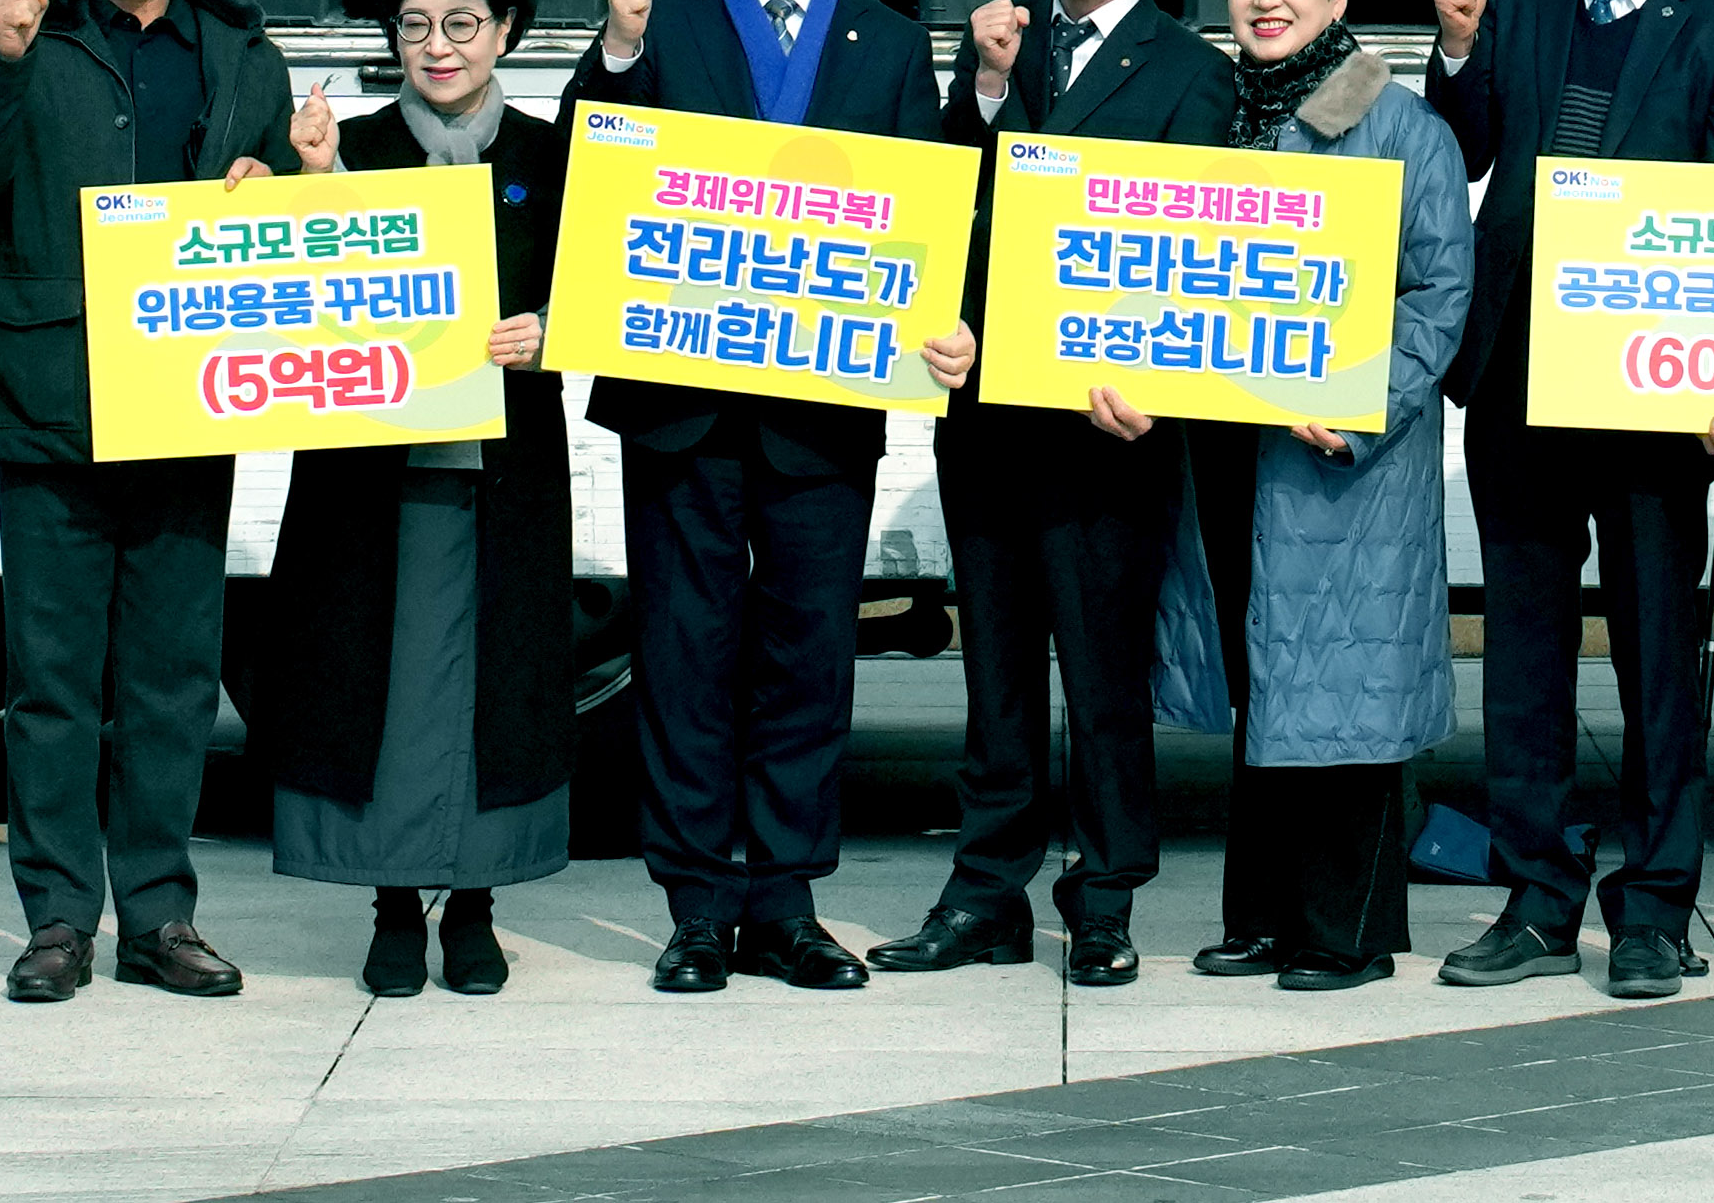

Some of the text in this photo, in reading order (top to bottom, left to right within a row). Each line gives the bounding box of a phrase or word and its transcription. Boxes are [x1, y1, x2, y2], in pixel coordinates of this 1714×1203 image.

[586, 130, 655, 147] Jeonnam
[624, 121, 656, 135] Now
[1011, 160, 1078, 175] Jeonnam
[1048, 150, 1079, 162] Now
[1590, 175, 1621, 187] Now
[97, 210, 166, 223] Jeonnam
[133, 197, 165, 209] Now
[655, 170, 891, 230] 경제위기극복!
[1089, 179, 1320, 227] 민생경제회복!
[179, 213, 418, 265] 소규모 음식점
[627, 219, 914, 305] 전라남도가
[1057, 230, 1344, 302] 전라남도가
[137, 272, 455, 333] 위생용품 꾸러미
[623, 301, 897, 379] 함께합니다
[1060, 311, 1330, 377] 앞장섭니다
[203, 346, 409, 413] (5억원)
